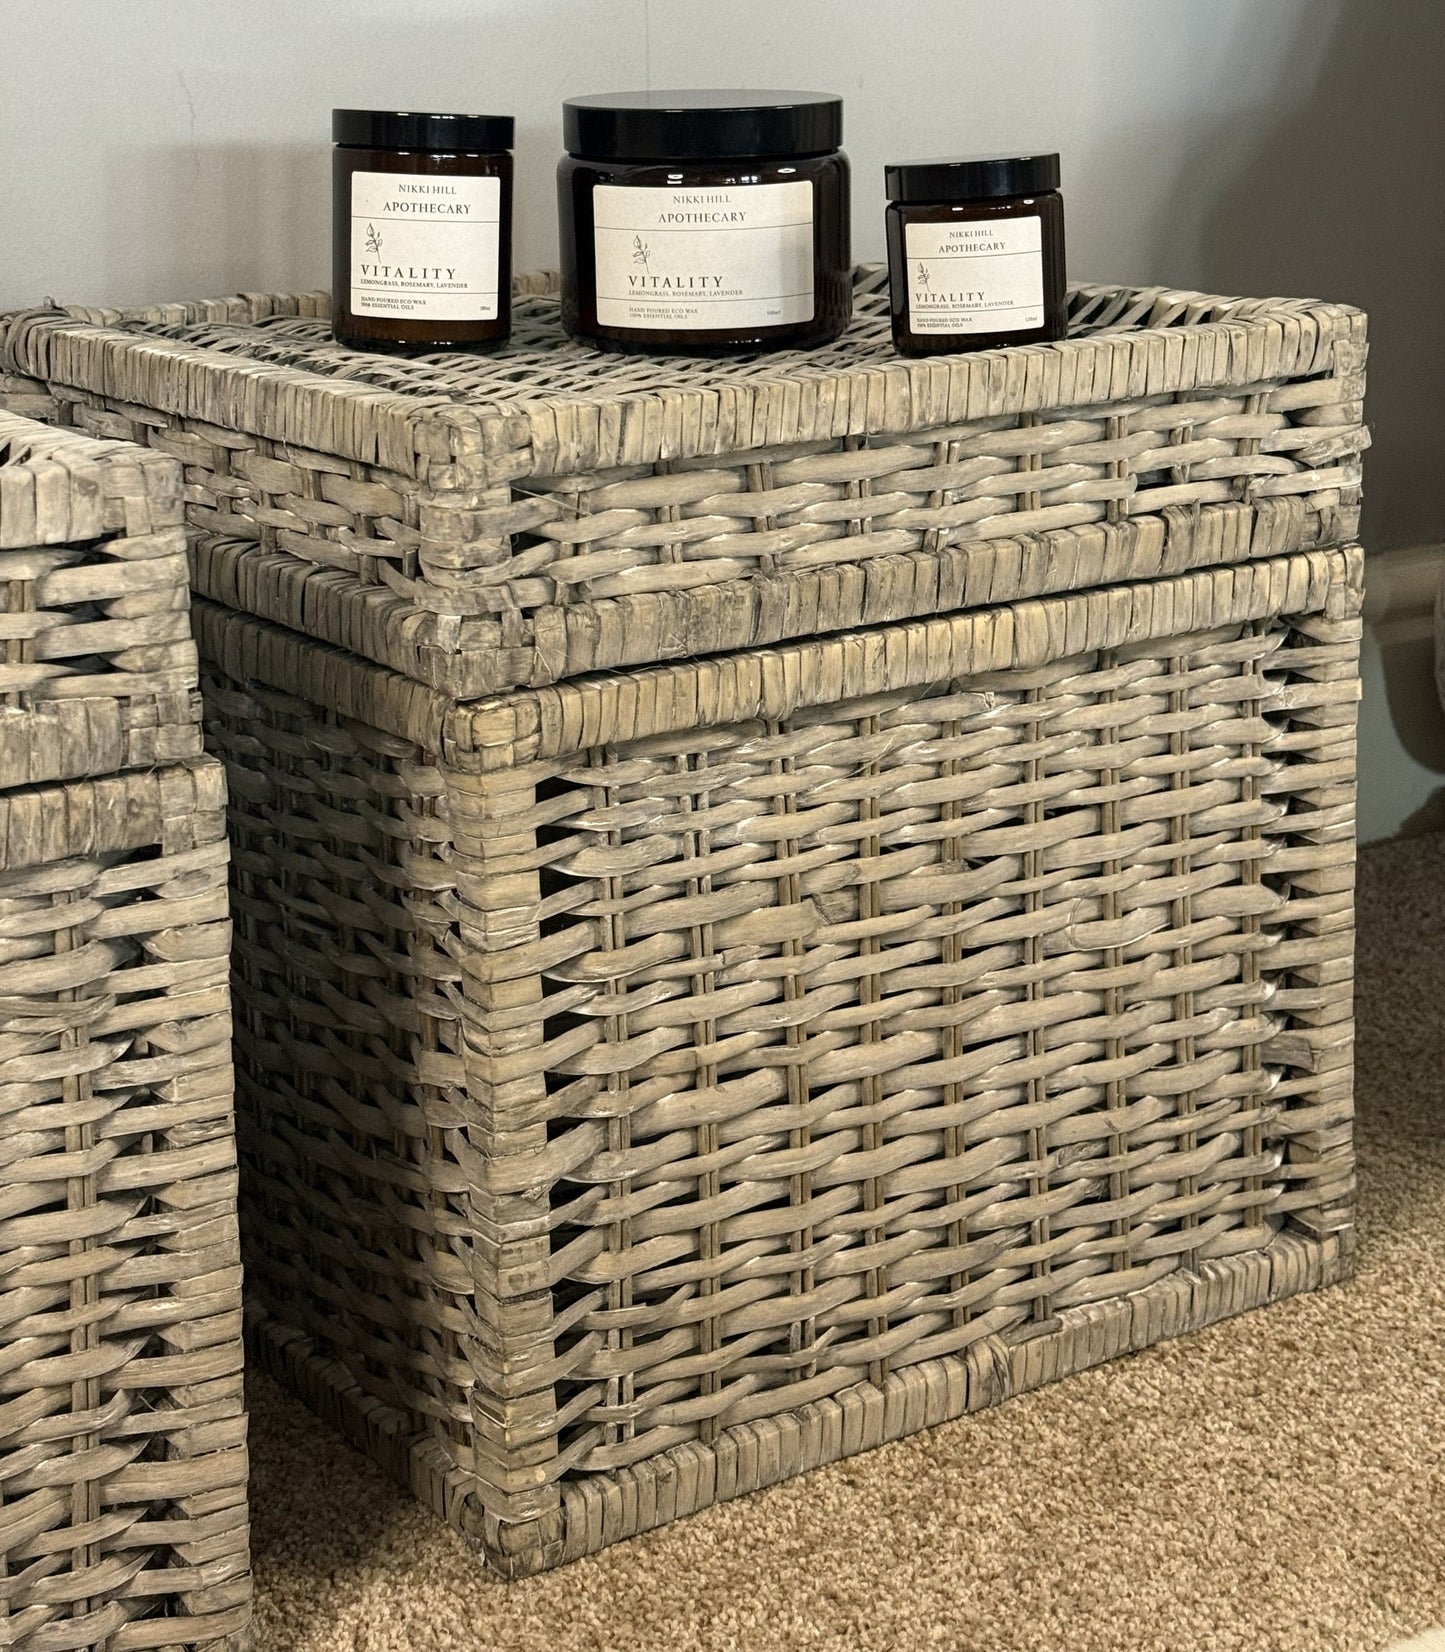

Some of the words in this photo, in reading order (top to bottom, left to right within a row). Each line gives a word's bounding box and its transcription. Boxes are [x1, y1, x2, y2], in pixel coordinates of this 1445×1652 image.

[399, 185, 429, 194] NIKKI
[432, 186, 457, 195] HILL
[673, 195, 704, 204] NIKKI
[707, 195, 731, 204] HILL
[383, 202, 471, 214] APOTHECARY
[659, 212, 746, 223] APOTHECARY
[939, 242, 1006, 253] APOTHECARY
[361, 264, 456, 279] VITALITY
[628, 276, 723, 288] VITALITY
[916, 292, 985, 302] VITALITY
